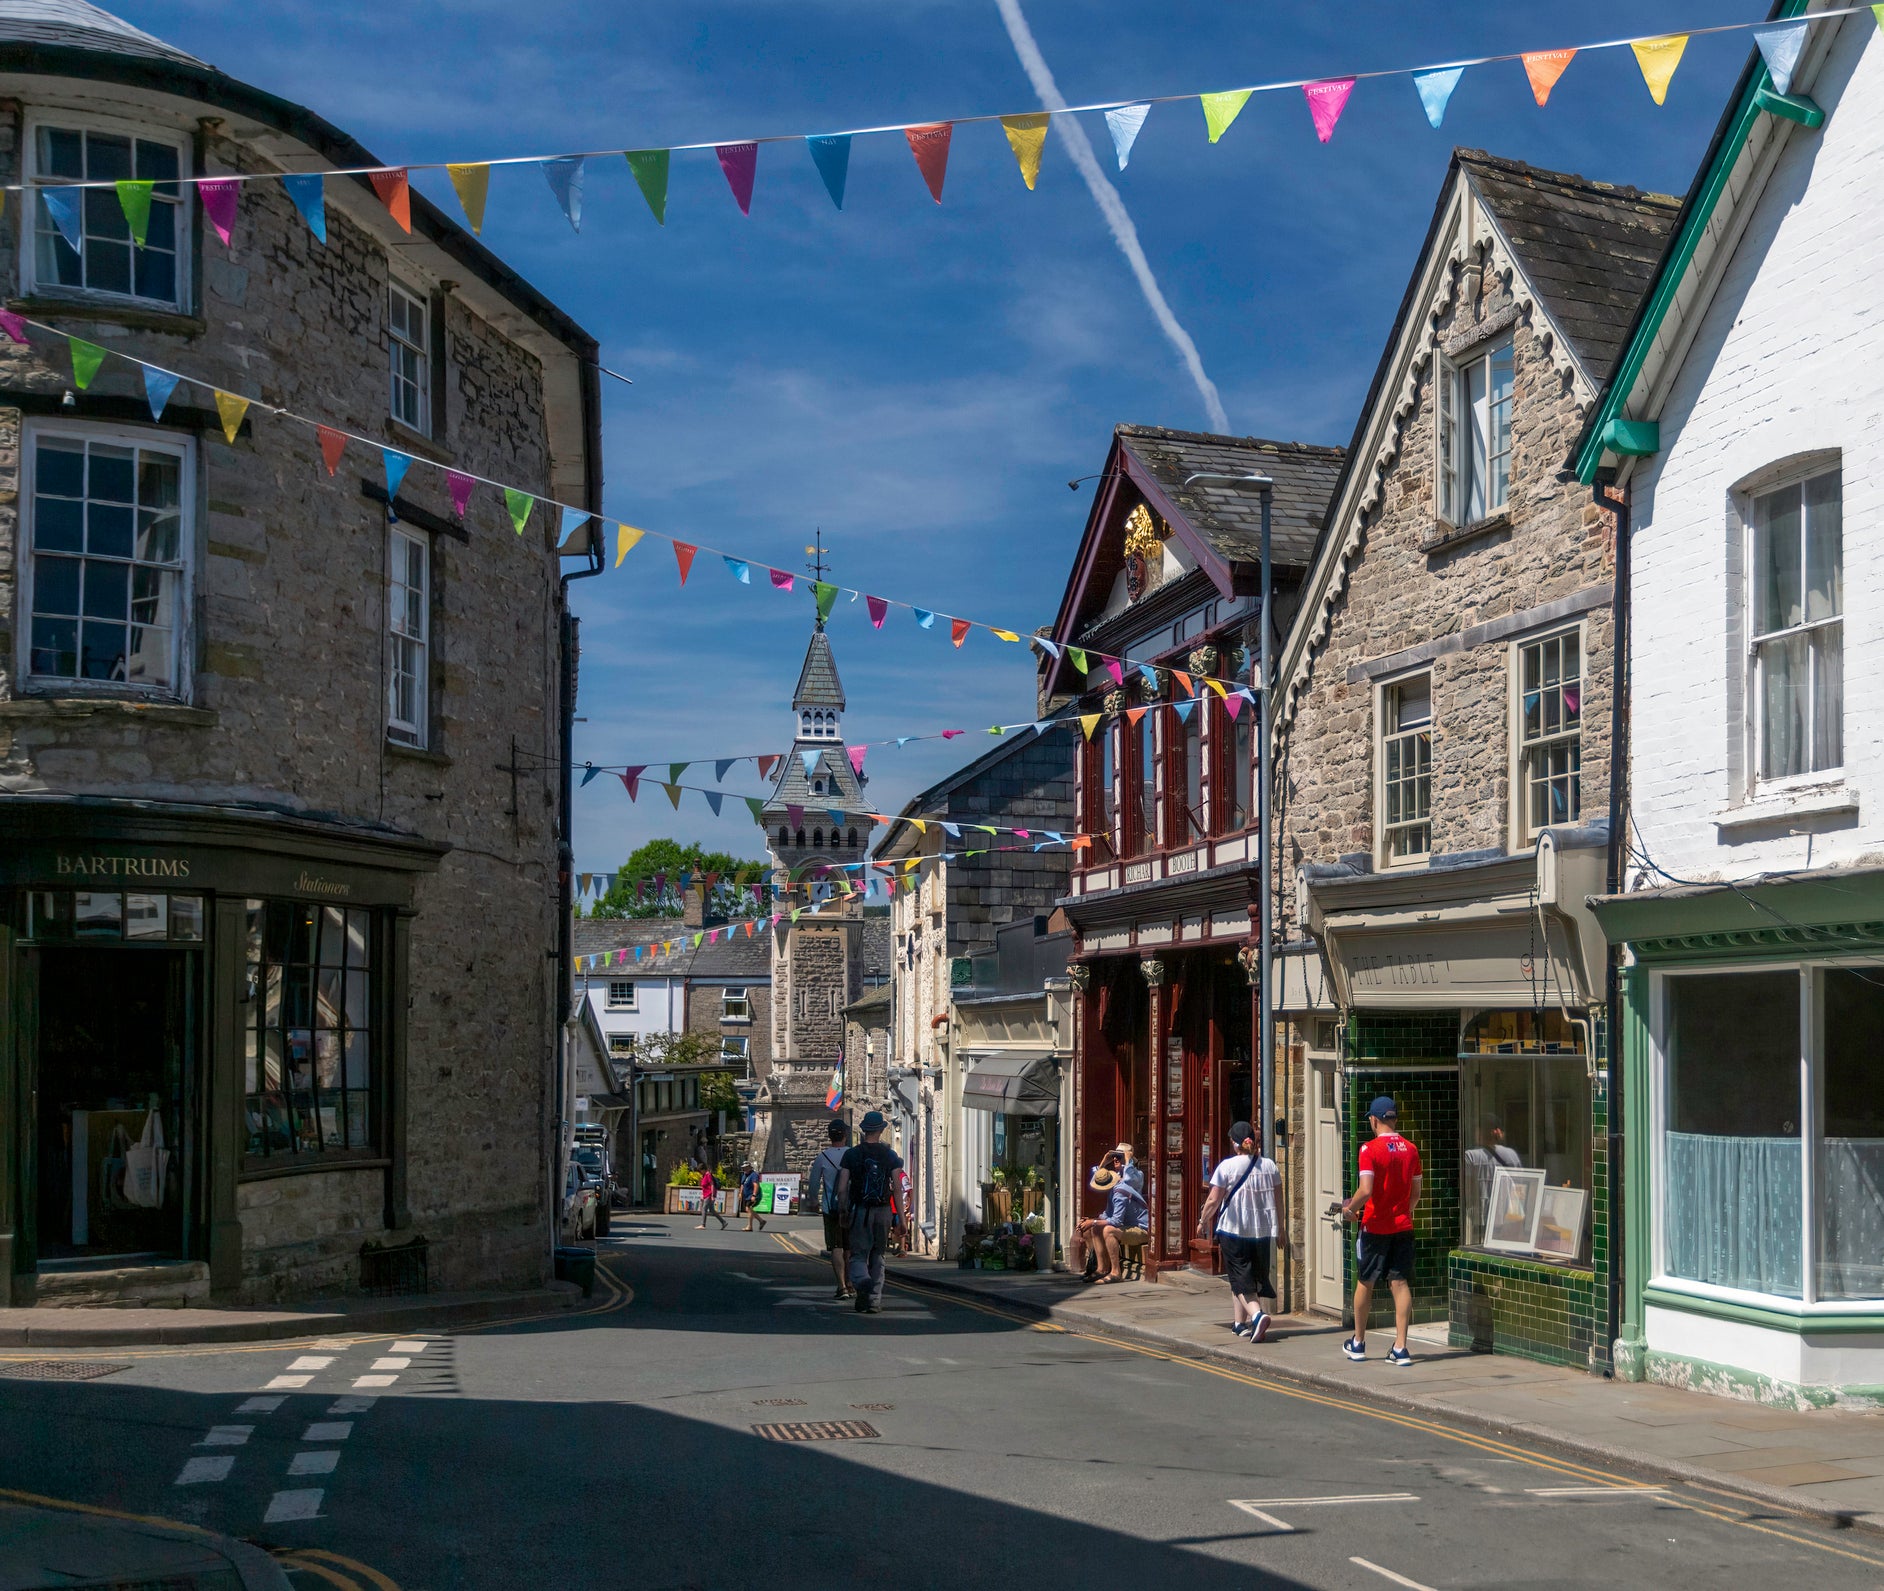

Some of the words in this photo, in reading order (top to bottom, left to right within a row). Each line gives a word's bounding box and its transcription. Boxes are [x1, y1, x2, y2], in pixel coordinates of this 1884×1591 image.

[1526, 52, 1569, 63] FESTIVAL
[1308, 84, 1349, 96] FESTIVAL
[911, 130, 949, 142] FESTIVAL
[720, 144, 755, 154] FESTIVAL
[372, 172, 405, 180] FESTIVAL
[201, 184, 235, 192] FESTIVAL
[56, 856, 190, 878] BARTRUMS
[294, 871, 350, 896] Stationers
[1352, 956, 1382, 985] THE
[1386, 953, 1439, 985] TABLE
